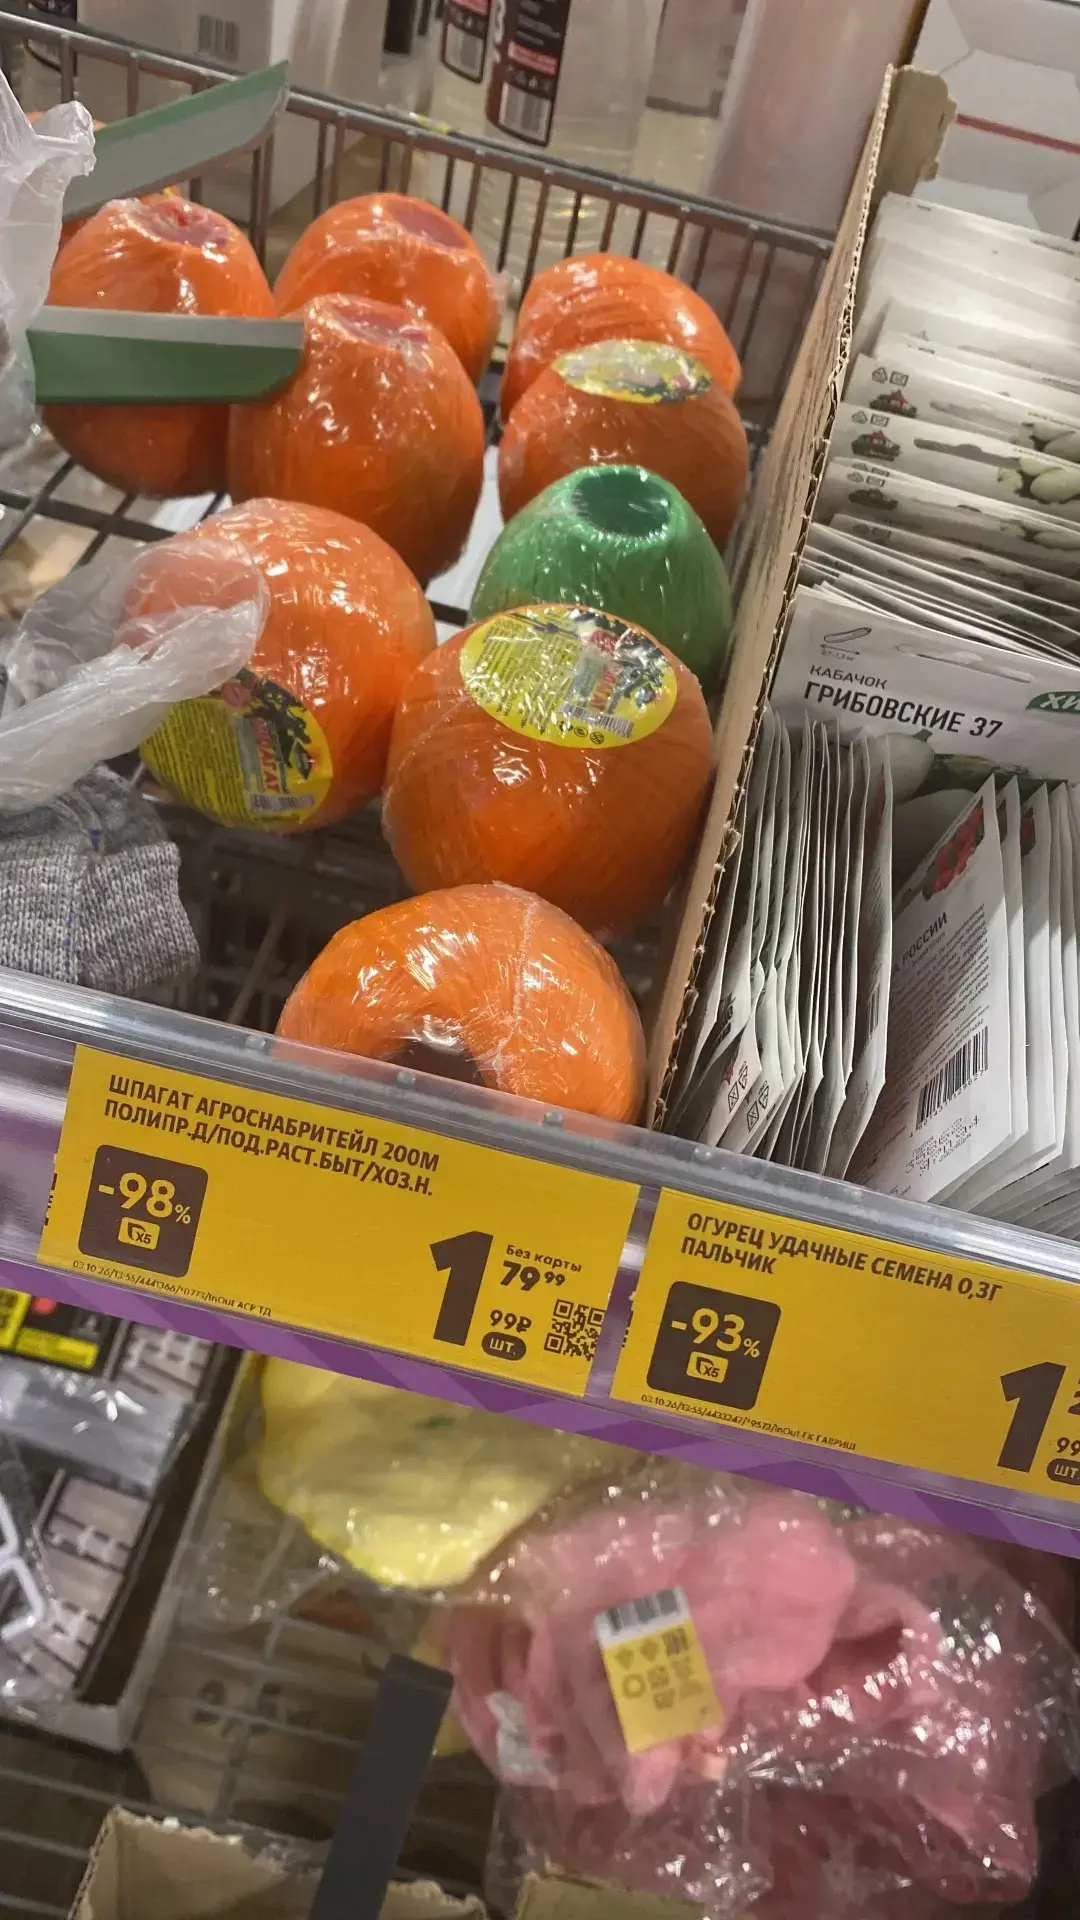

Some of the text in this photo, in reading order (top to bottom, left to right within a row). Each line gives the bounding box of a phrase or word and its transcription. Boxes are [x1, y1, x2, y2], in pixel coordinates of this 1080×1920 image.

[809, 664, 888, 690] КАБАЧОК
[804, 681, 1004, 740] ГРИБОВСКИЕ 37
[902, 911, 948, 966] РОССИИ
[103, 1098, 434, 1197] ПОЛИПР.Д/ПОД.РАСТ.БЫТ/ХОЗ.Н.
[109, 1074, 440, 1173] ШПАГАТ АГРОСНАБРИТЕЙЛ 200М
[98, 1172, 192, 1226] -98%
[506, 1244, 582, 1273] Без карты
[680, 1236, 777, 1275] ПАЛЬЧИК
[686, 1211, 1003, 1302] ОГУРЕЦ УДАЧНЫЕ СЕМЕНА 0,3Г
[429, 1229, 494, 1347] 1
[670, 1307, 761, 1359] -93%
[996, 1361, 1067, 1474] 1
